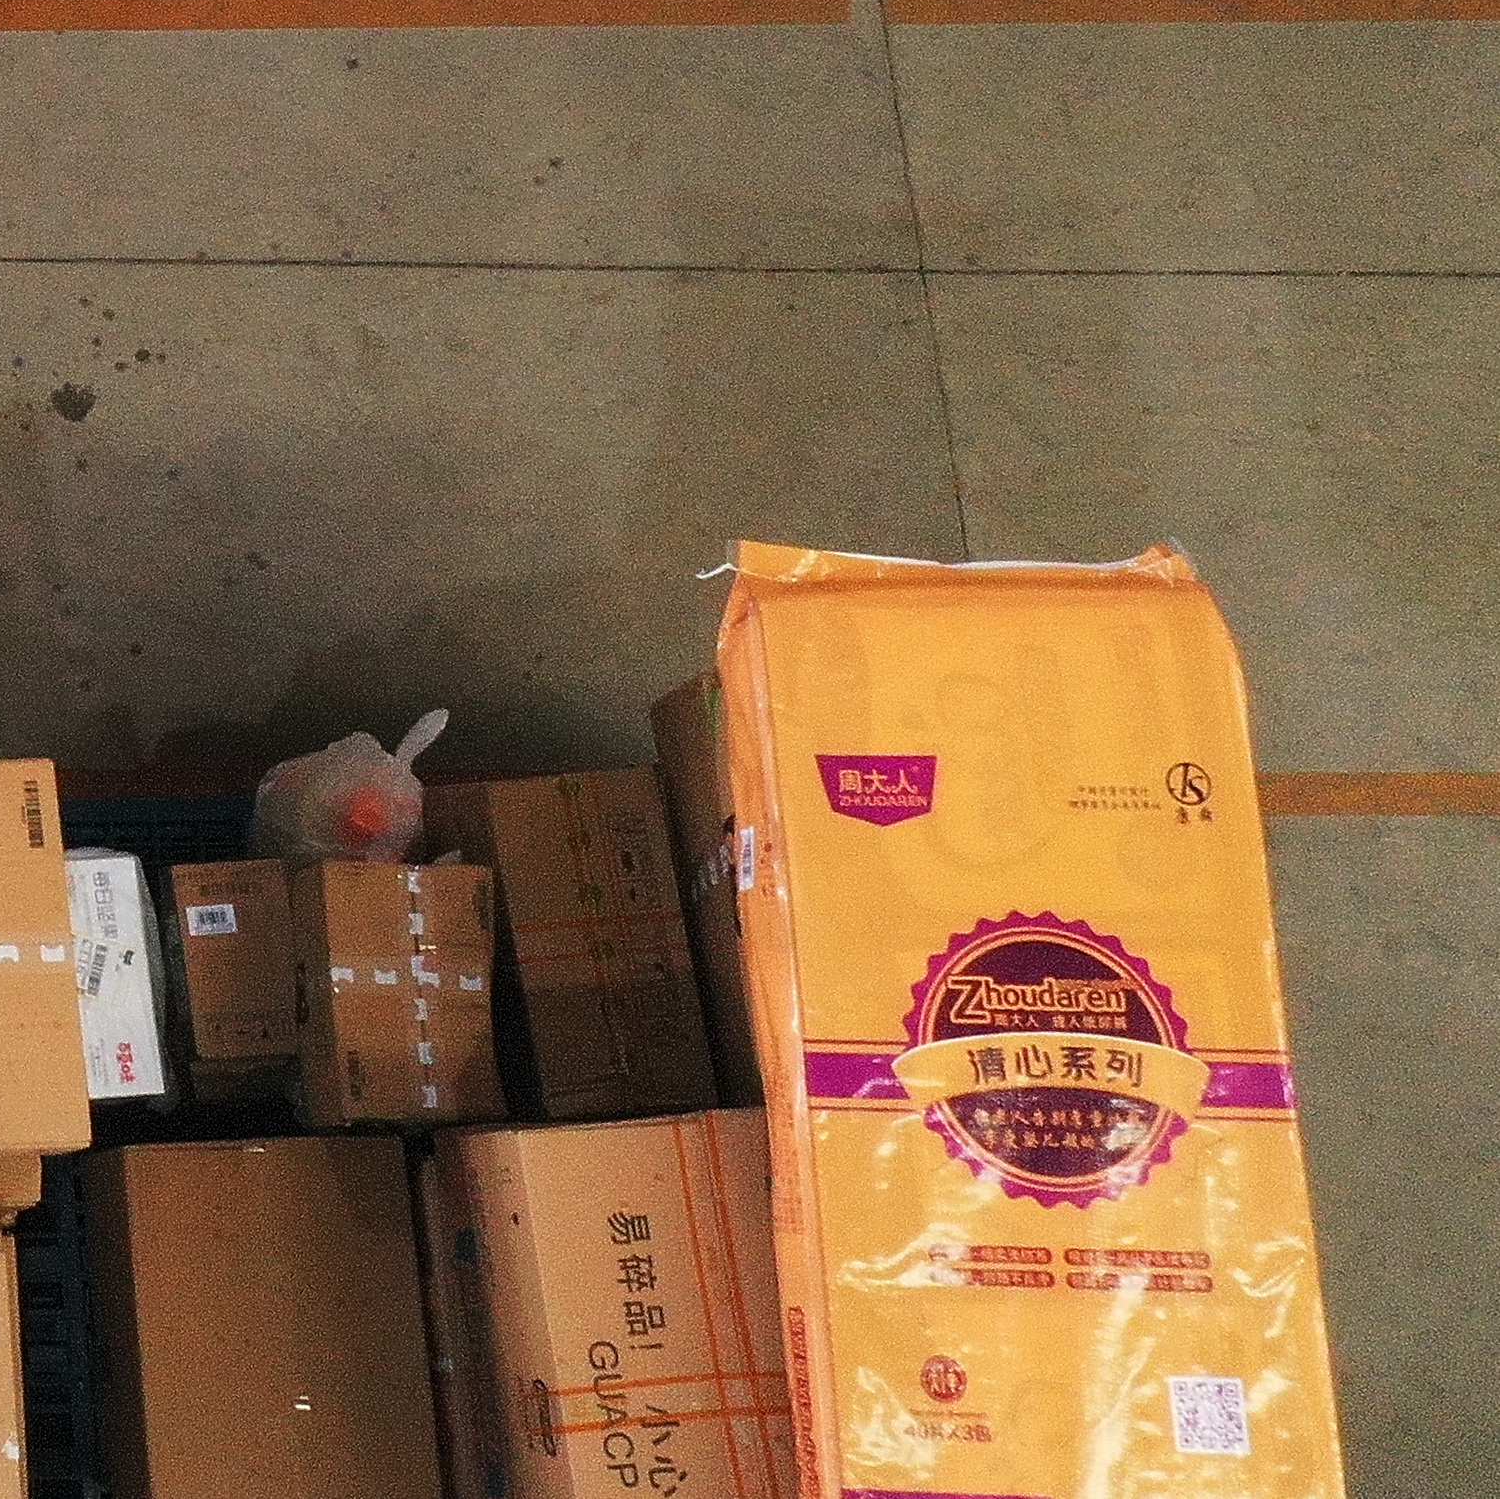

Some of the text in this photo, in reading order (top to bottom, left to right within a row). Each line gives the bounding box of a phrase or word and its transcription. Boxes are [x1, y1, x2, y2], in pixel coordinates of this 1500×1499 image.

[838, 768, 919, 793] 周大人
[949, 976, 1126, 1023] Zhoudaren
[967, 1045, 1144, 1087] 清心系列
[607, 1211, 666, 1353] 易碎品!
[588, 1340, 639, 1489] GUACP
